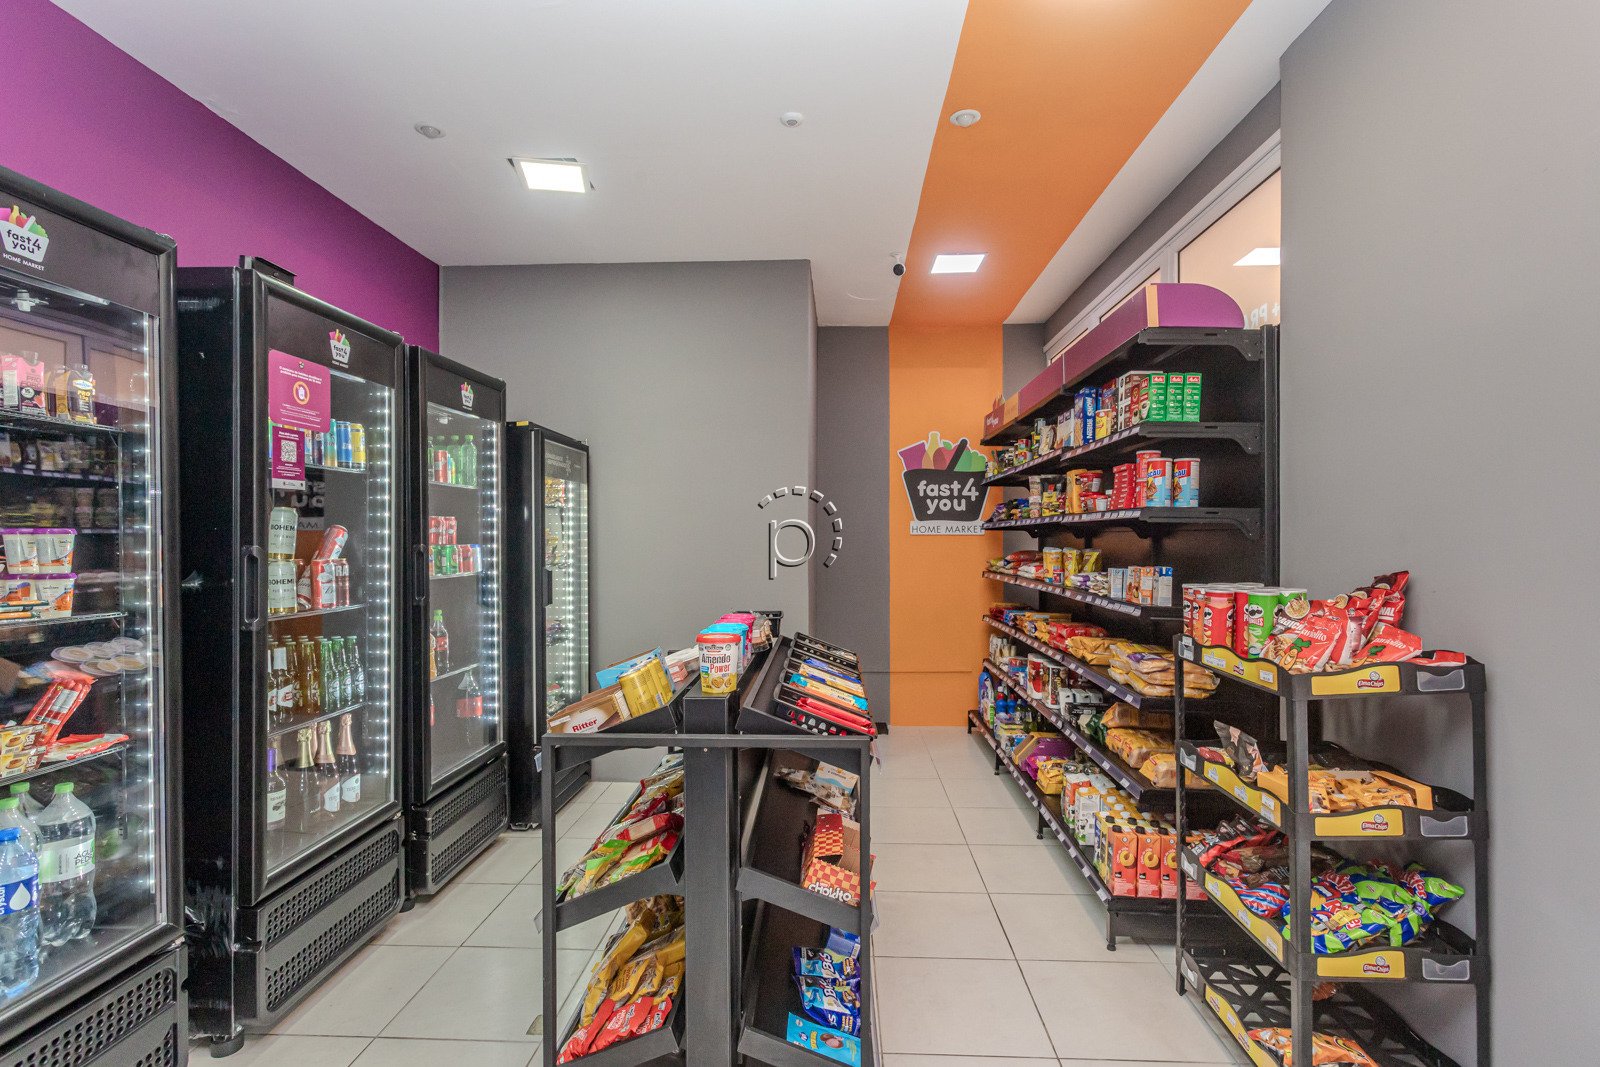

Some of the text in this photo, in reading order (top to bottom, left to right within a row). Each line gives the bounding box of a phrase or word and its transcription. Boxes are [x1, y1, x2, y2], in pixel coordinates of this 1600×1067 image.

[7, 229, 41, 251] fast4
[12, 240, 35, 254] you
[3, 252, 45, 271] HOME MARKET
[917, 478, 979, 501] fast4
[926, 498, 966, 515] you
[911, 525, 941, 534] HOME
[701, 653, 731, 664] Amendo
[709, 664, 730, 673] Power
[571, 718, 598, 733] Ritter
